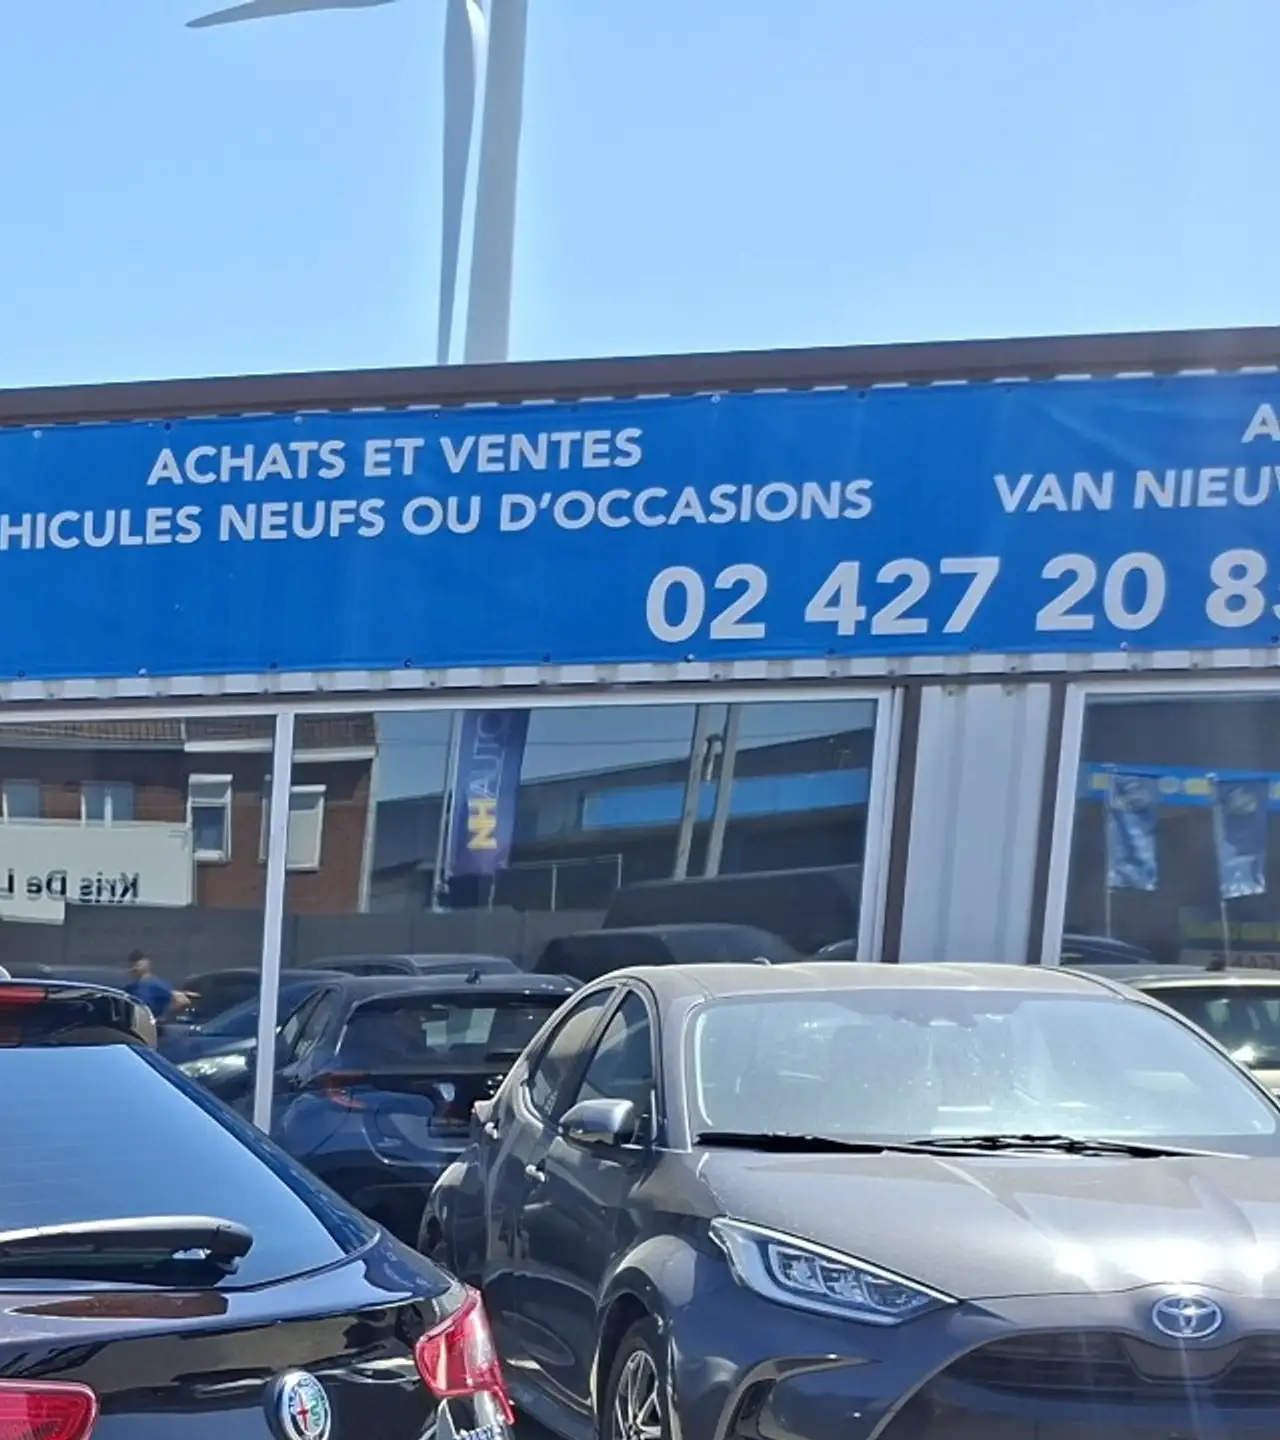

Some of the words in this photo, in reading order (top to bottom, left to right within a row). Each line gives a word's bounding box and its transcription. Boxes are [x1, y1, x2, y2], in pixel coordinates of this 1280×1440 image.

[146, 439, 346, 486] ACHATS
[363, 437, 425, 477] ET
[440, 427, 643, 474] VENTES
[993, 471, 1114, 514] VAN
[1133, 464, 1280, 510] NIEU
[219, 499, 386, 542] NEUFS
[402, 495, 482, 536] OU
[645, 563, 769, 643] 02
[804, 556, 1001, 636] 427
[1035, 551, 1168, 632] 20
[1205, 548, 1280, 628] 8
